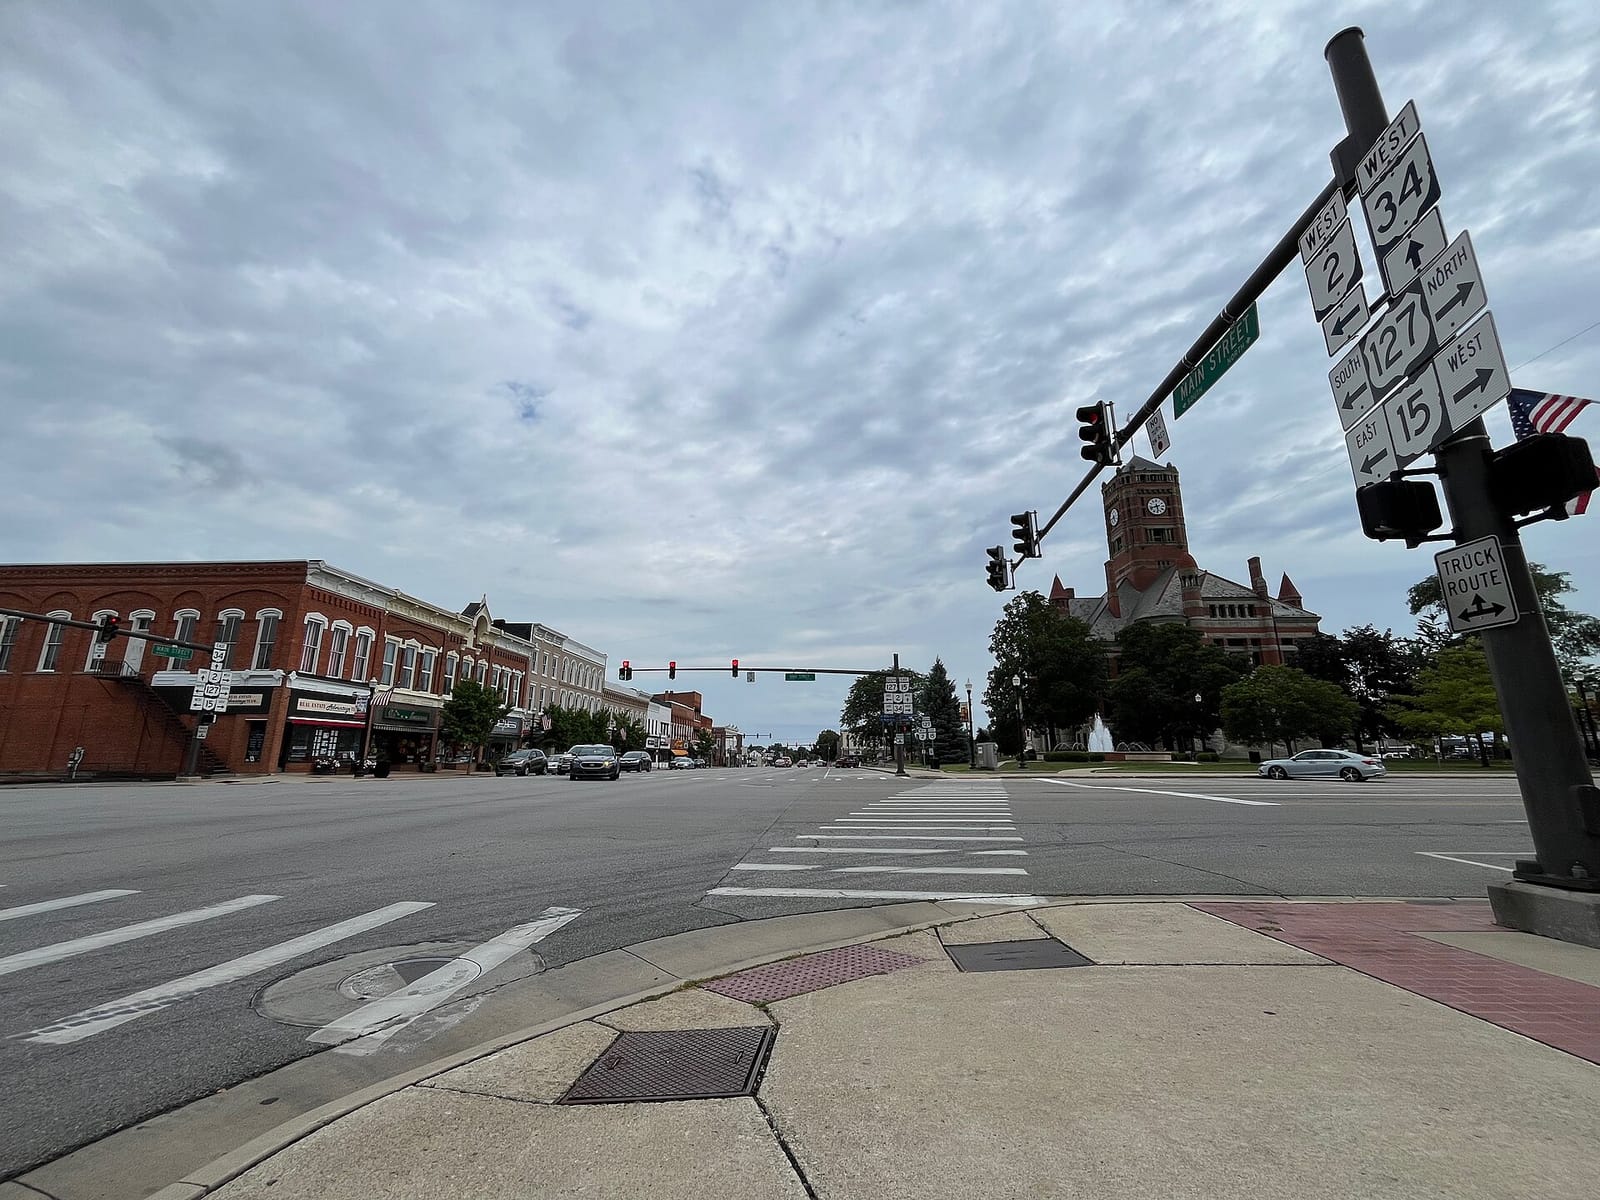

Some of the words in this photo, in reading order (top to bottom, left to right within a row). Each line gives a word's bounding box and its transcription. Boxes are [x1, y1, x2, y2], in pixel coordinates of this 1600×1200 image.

[1363, 116, 1410, 180] WEST
[1372, 159, 1424, 235] 34
[1304, 204, 1340, 251] WEST
[1322, 252, 1345, 294] 2
[1426, 246, 1469, 297] NORTH
[1179, 366, 1206, 401] MAIN
[1209, 314, 1250, 371] STREET
[1369, 300, 1416, 376] 127
[1447, 332, 1483, 373] WEST
[1334, 355, 1362, 389] SOUTH
[1150, 416, 1158, 429] NO
[1356, 421, 1378, 449] EAST
[1396, 388, 1430, 442] 15
[1442, 547, 1496, 576] TRUCK
[1447, 569, 1502, 597] ROUTE
[206, 686, 219, 694] 127
[211, 673, 218, 681] 2
[205, 700, 214, 708] 15
